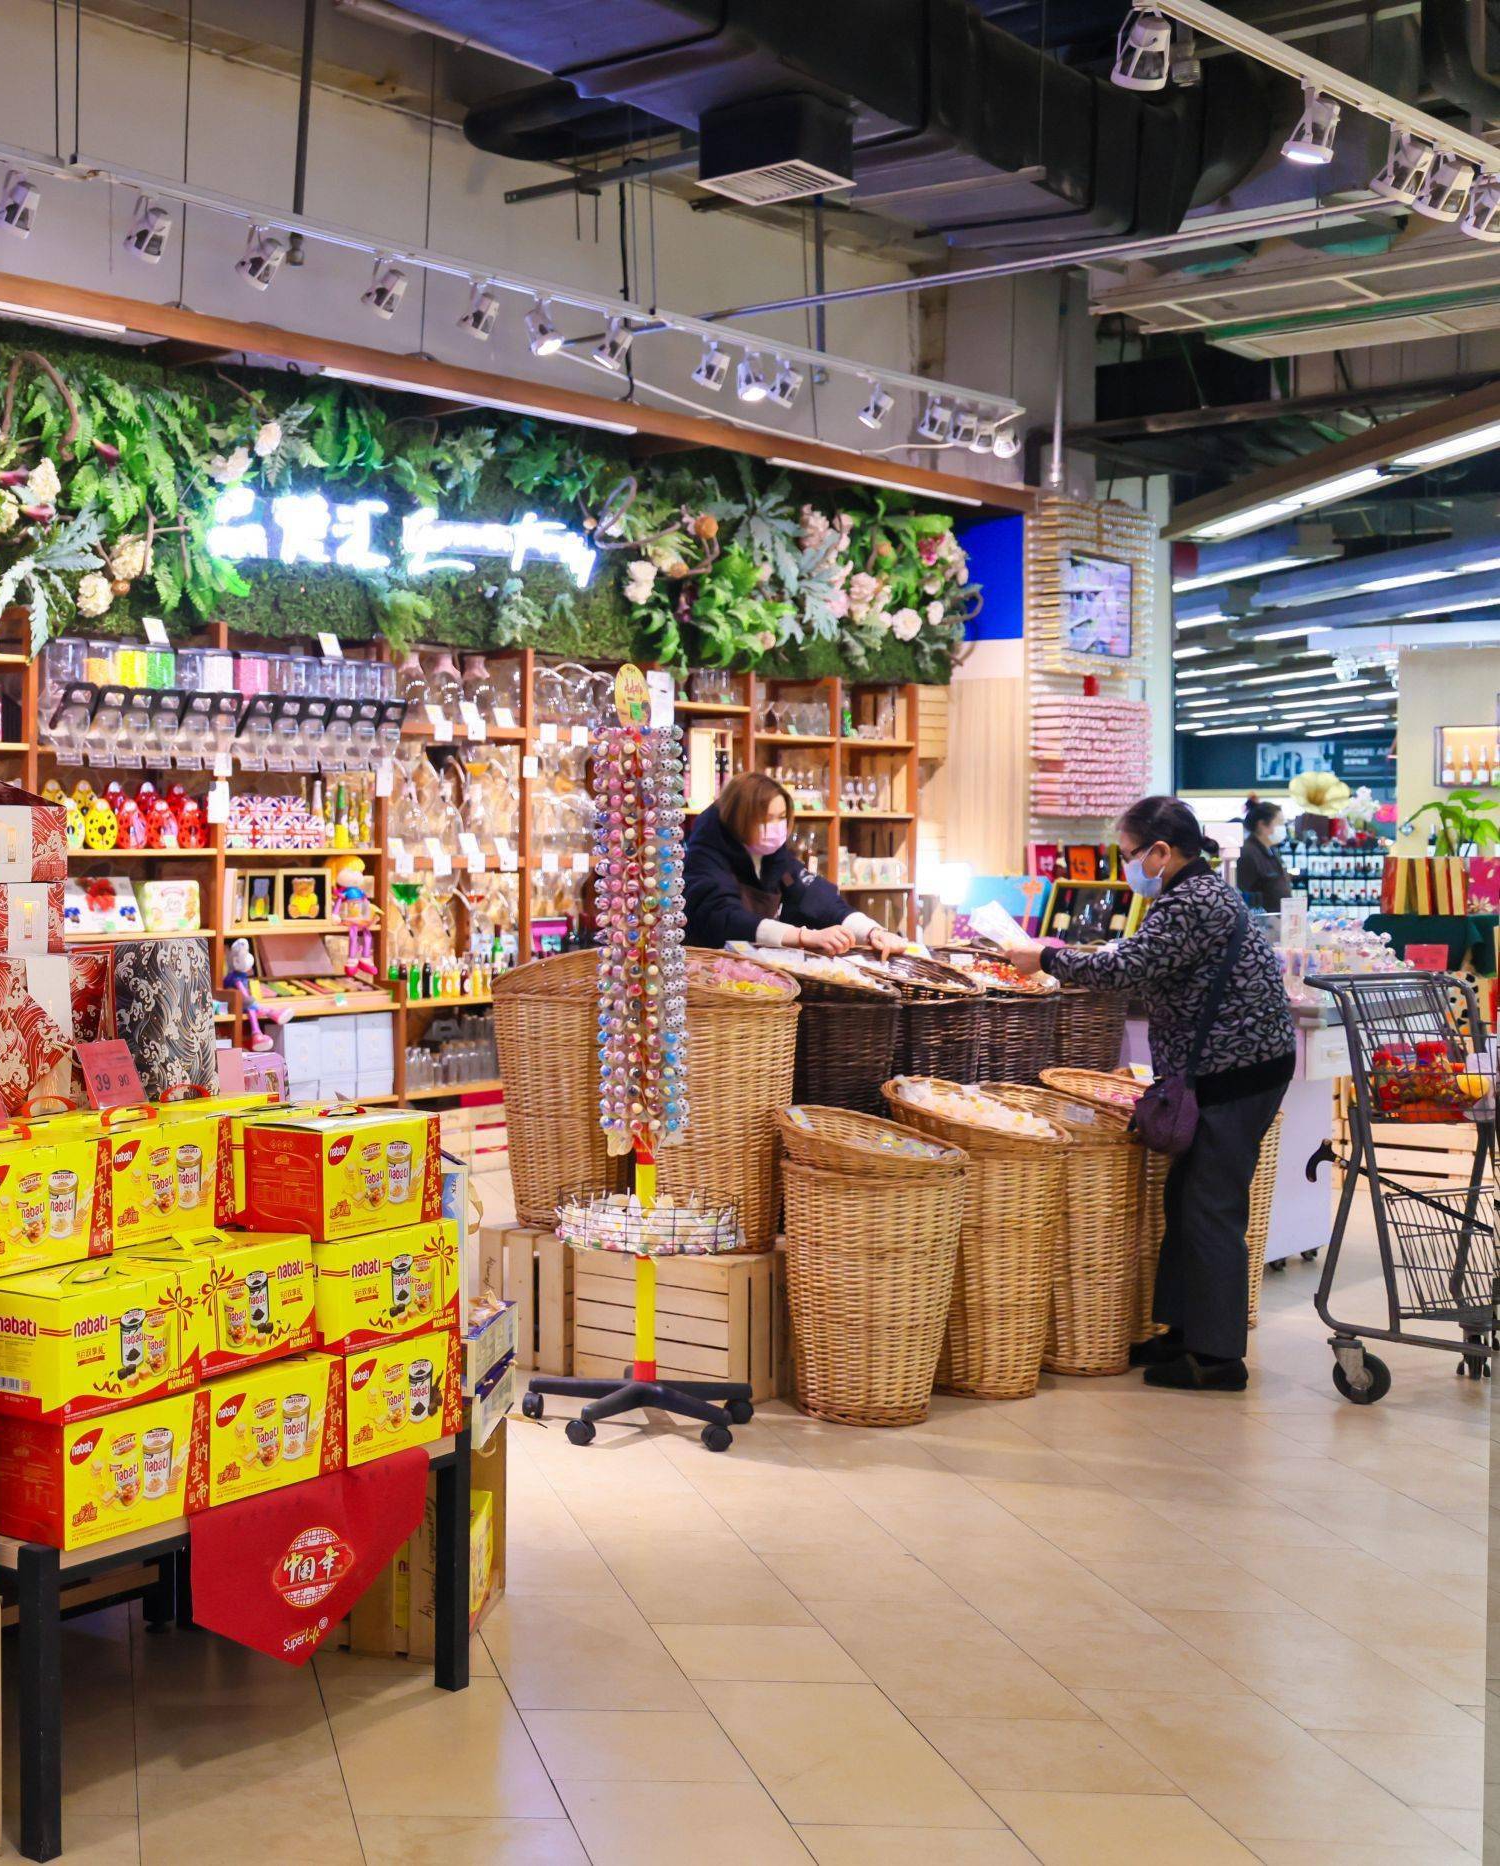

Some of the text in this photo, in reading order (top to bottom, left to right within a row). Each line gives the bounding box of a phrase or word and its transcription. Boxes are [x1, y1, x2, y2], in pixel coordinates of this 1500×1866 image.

[21, 1201, 45, 1219] nabati
[50, 1199, 74, 1213] nabati
[277, 1258, 304, 1280] nabati
[351, 1259, 381, 1279] nabati
[73, 1315, 109, 1338] nabati
[256, 1427, 279, 1443] nabati
[114, 1463, 139, 1483] nabati
[144, 1456, 169, 1473] nabati
[283, 1545, 340, 1585] 中国年
